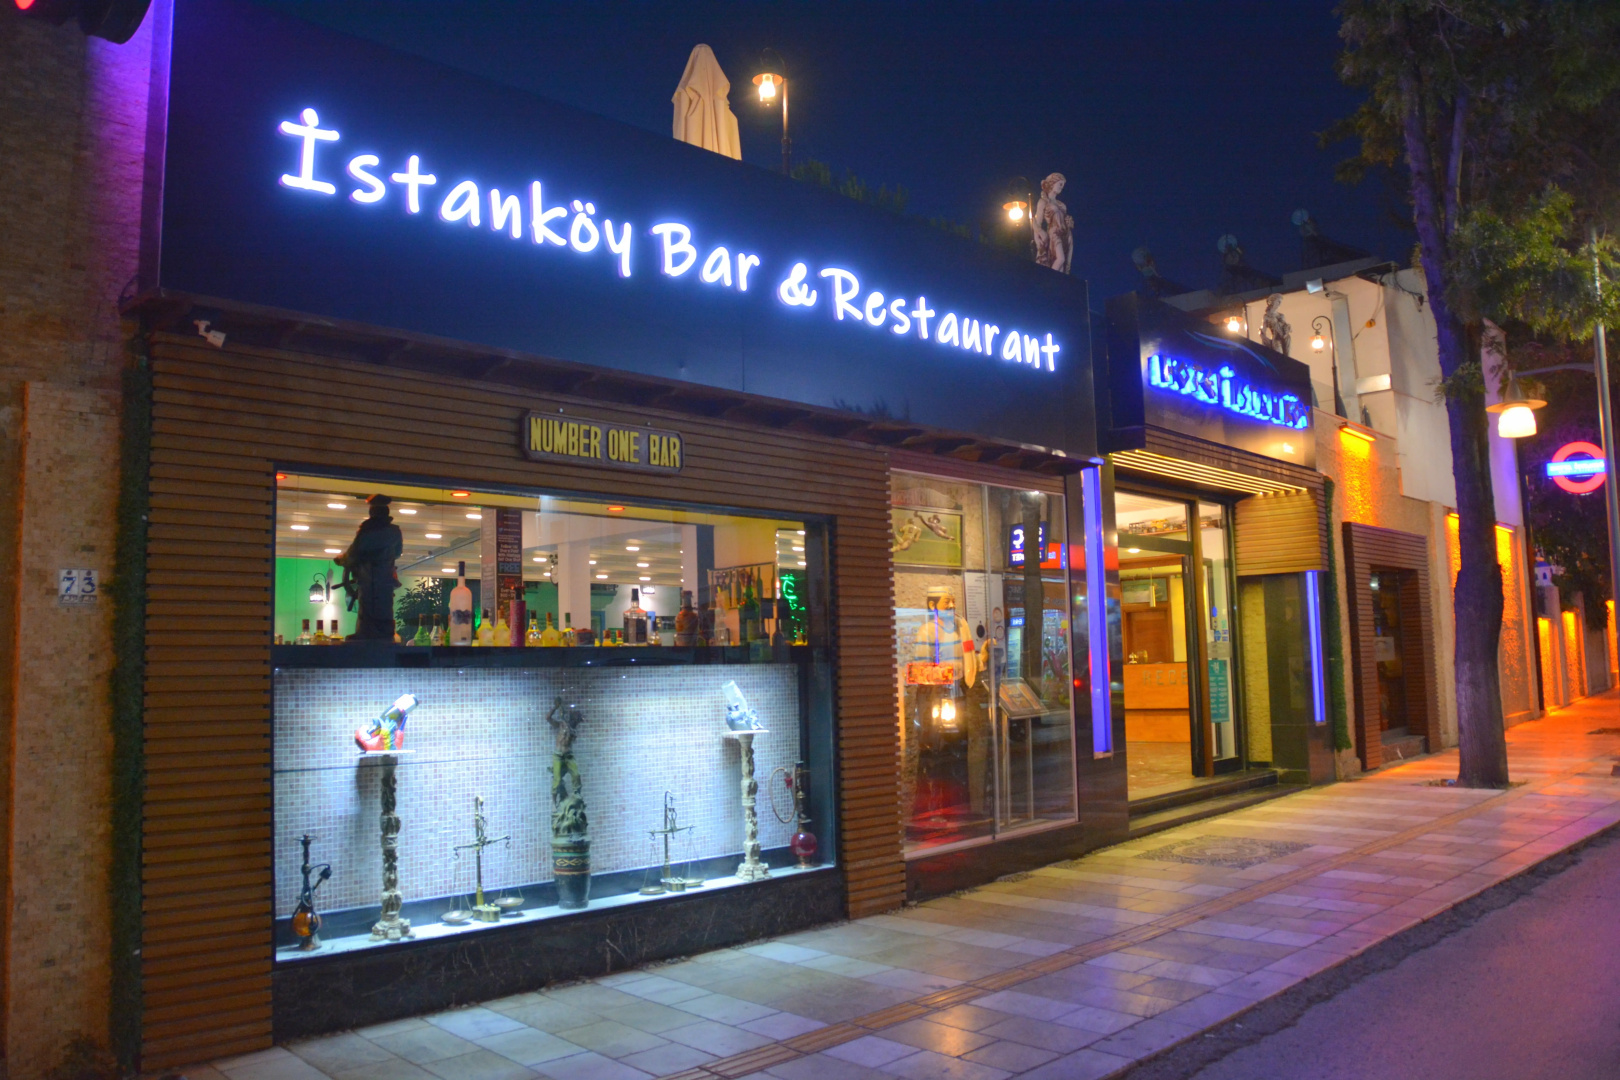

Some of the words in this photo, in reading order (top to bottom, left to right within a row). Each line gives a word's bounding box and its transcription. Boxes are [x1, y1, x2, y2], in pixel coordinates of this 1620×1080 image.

[651, 222, 760, 292] Bar
[818, 266, 1061, 373] Restaurant
[530, 417, 602, 459] NUMBER
[608, 428, 640, 463] ONE
[649, 434, 681, 468] BAR
[499, 562, 521, 573] FREE
[62, 576, 96, 594] 73
